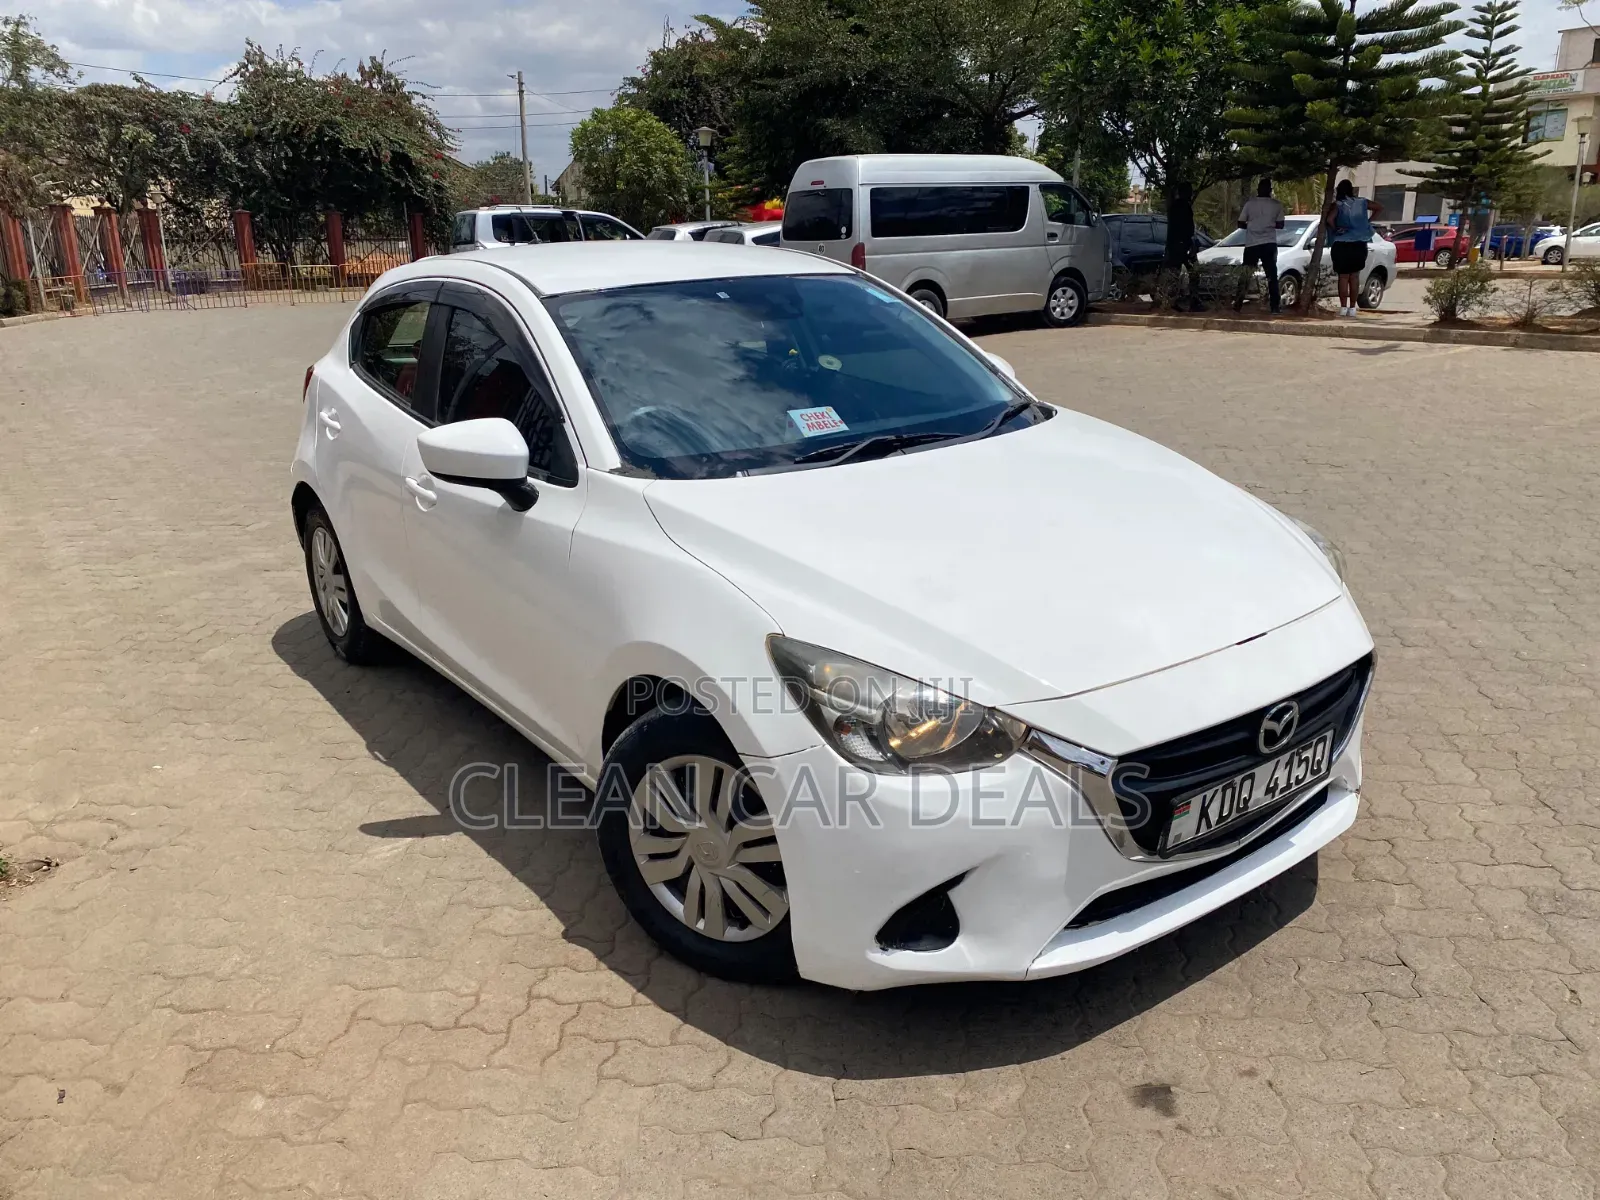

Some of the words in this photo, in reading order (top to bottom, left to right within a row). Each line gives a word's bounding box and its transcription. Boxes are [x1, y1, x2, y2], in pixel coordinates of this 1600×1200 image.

[805, 419, 841, 432] MBELE
[1195, 771, 1256, 836] KDQ
[1264, 735, 1328, 800] 415Q
